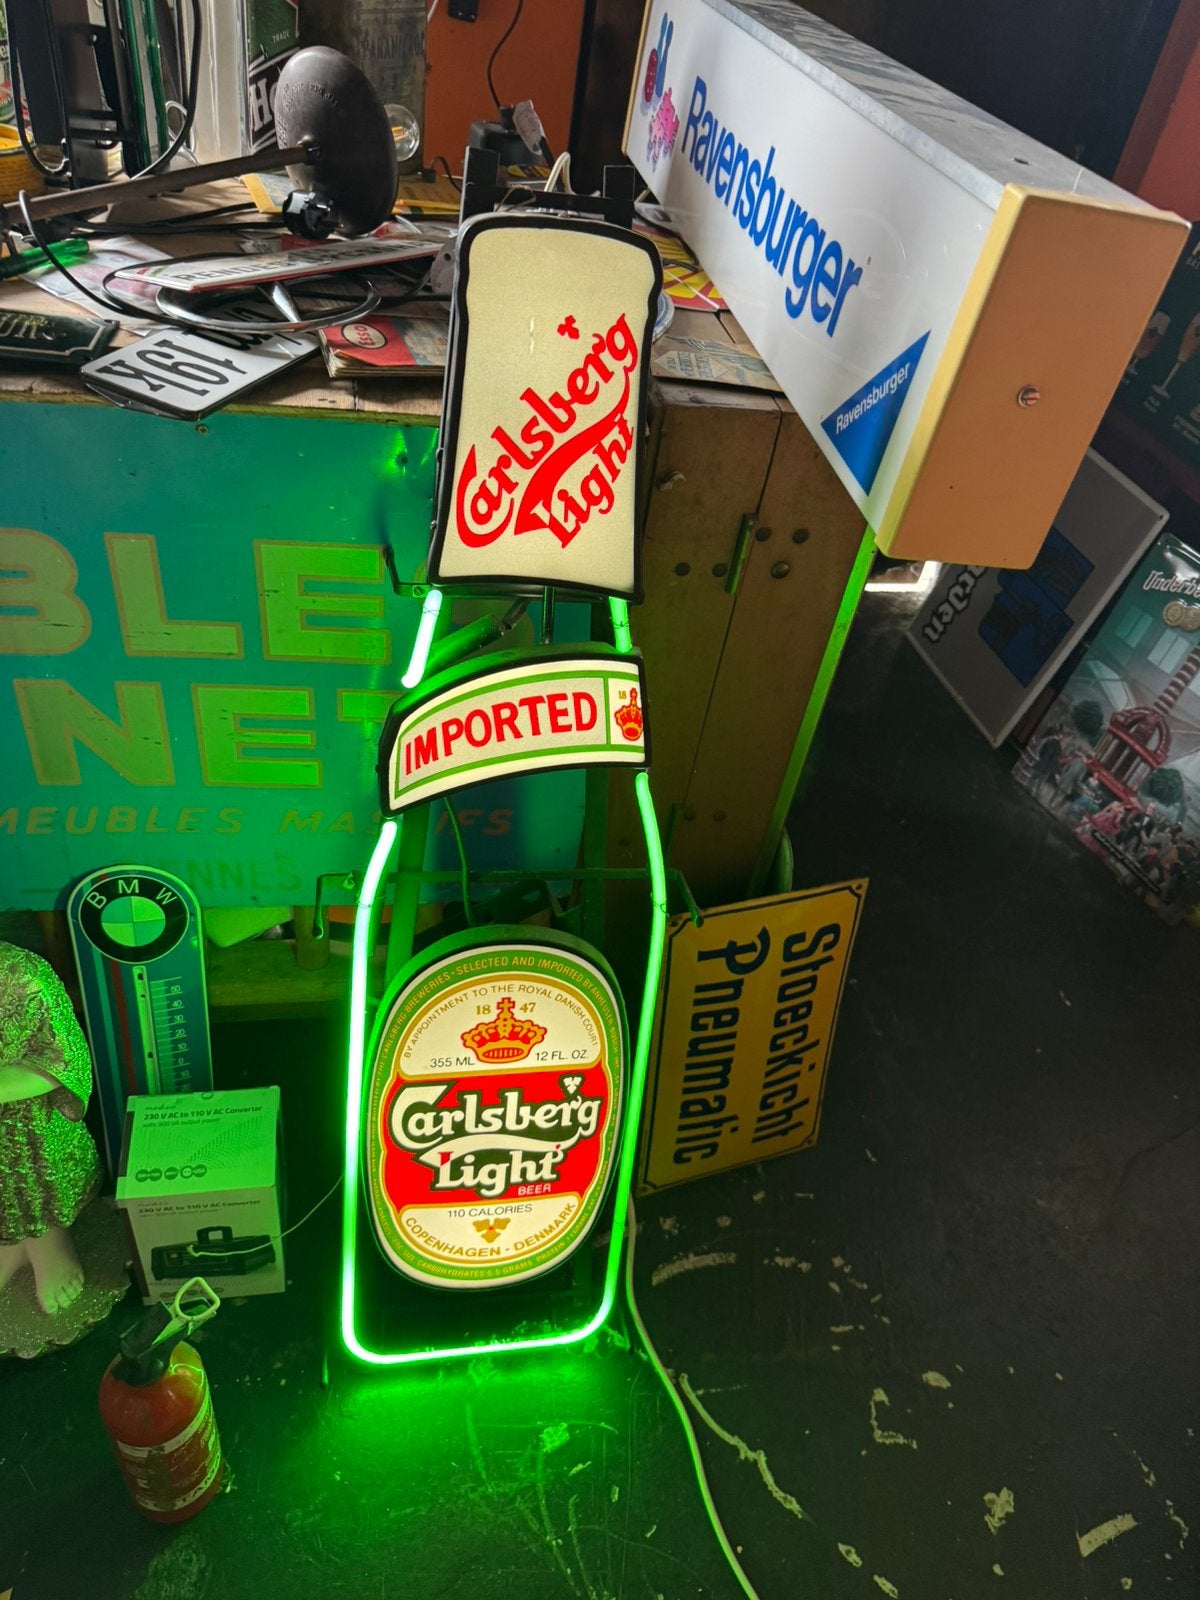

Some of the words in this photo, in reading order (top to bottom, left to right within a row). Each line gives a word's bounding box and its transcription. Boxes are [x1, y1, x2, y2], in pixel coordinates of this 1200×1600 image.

[682, 75, 864, 337] Ravensburger
[834, 361, 911, 434] Ravensburger
[456, 313, 638, 548] Carlsberg
[529, 413, 634, 549] Light
[618, 690, 627, 700] 18
[404, 691, 598, 775] IMPORTED
[86, 878, 178, 909] BMW
[381, 1012, 407, 1059] CARLSBERG
[402, 971, 451, 1013] BREWERIES
[455, 956, 508, 976] SELECTED
[511, 956, 535, 967] AND
[537, 957, 583, 984] IMPORTED
[582, 978, 594, 989] BY
[404, 1046, 414, 1059] BY
[411, 993, 470, 1046] APPOINTMENT
[472, 988, 488, 998] TO
[491, 984, 514, 993] THE
[517, 984, 552, 998] ROYAL
[554, 993, 585, 1020] DANISH
[582, 1018, 598, 1046] COURT
[475, 1005, 491, 1015] 18
[520, 1002, 536, 1013] 47
[751, 922, 841, 1145] Stoeckicht
[430, 1057, 453, 1069] 355
[455, 1055, 475, 1067] ML
[535, 1051, 548, 1061] 12
[551, 1050, 568, 1060] FL.
[672, 925, 771, 1165] Pneumatic
[144, 1112, 159, 1120] 230
[168, 1111, 179, 1119] AC
[180, 1110, 189, 1118] to
[225, 1105, 263, 1114] Converter
[391, 1085, 601, 1149] Carlsberg
[435, 1144, 564, 1198] Light
[517, 1184, 552, 1197] BEER
[222, 1199, 261, 1207] Converter
[405, 1217, 500, 1257] COPENHAGEN
[513, 1203, 576, 1250] DENMARK
[447, 1208, 465, 1218] 110
[468, 1203, 533, 1217] CALORIES
